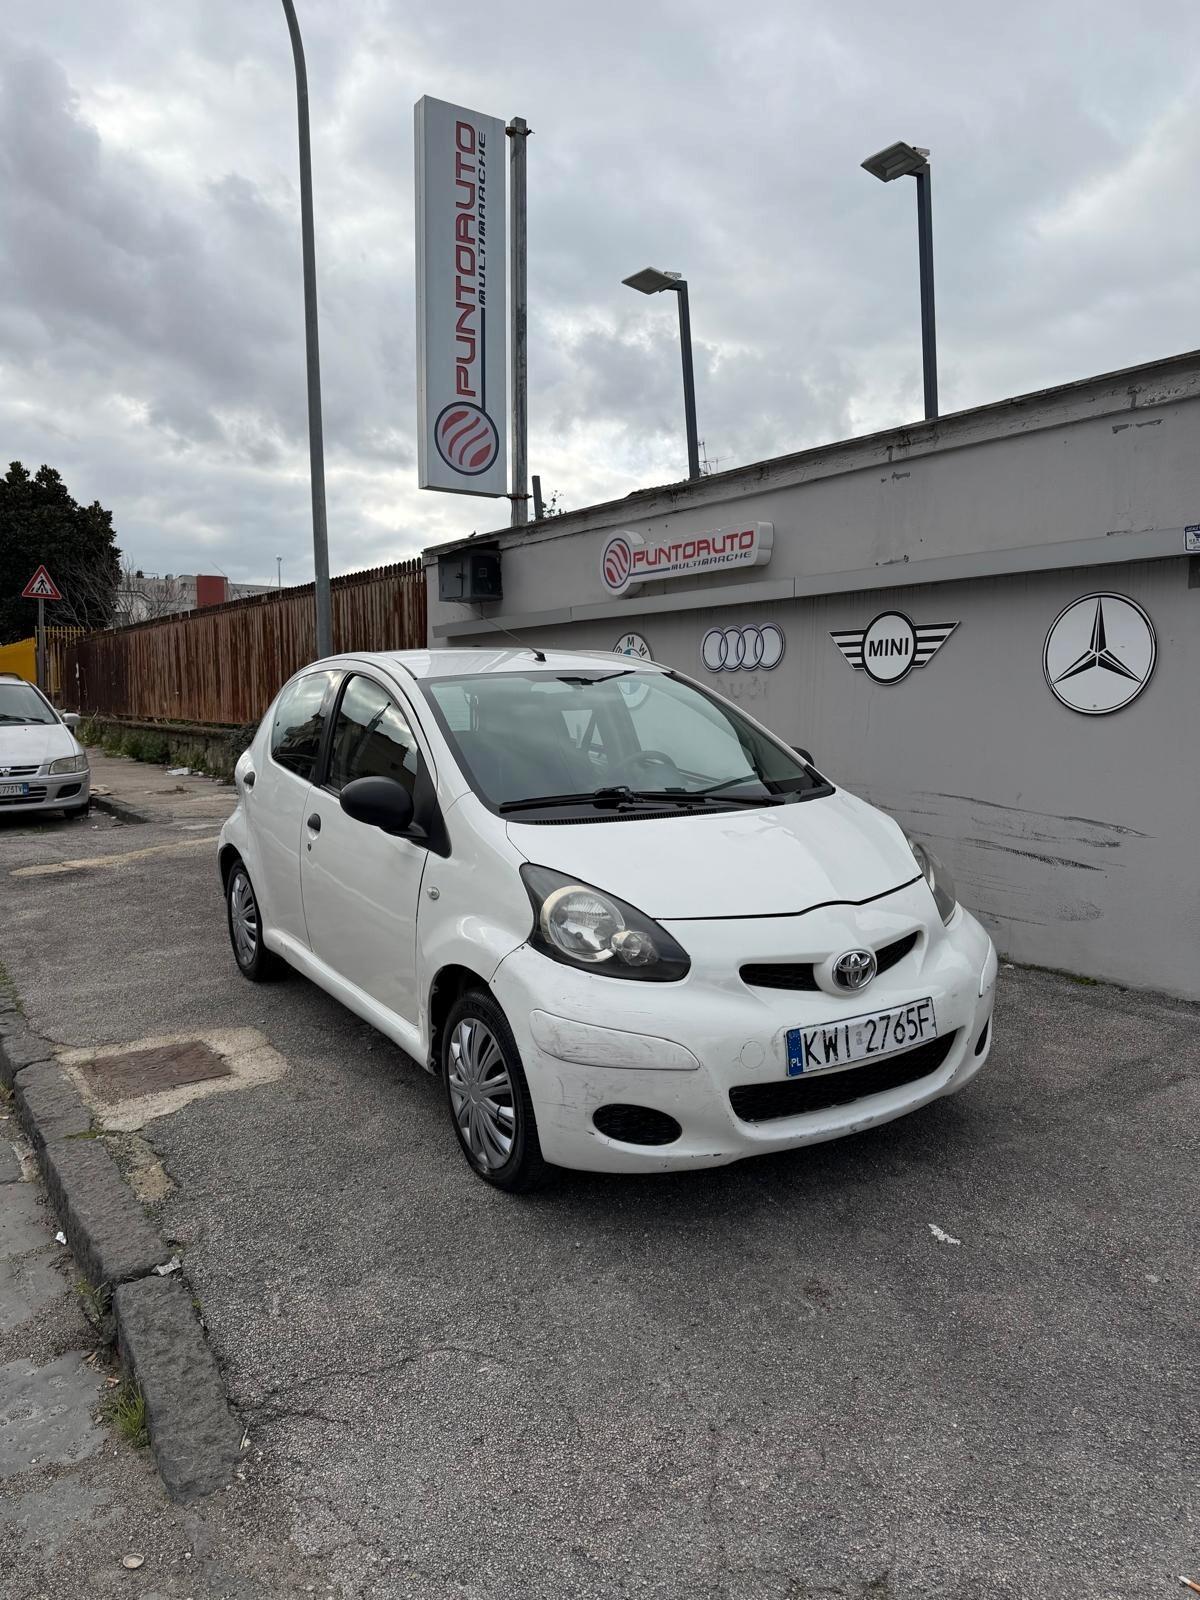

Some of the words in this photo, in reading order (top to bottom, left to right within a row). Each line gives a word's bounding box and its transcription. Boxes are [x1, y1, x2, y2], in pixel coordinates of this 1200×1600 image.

[478, 130, 486, 306] MULTIMARCHE
[455, 120, 477, 397] PUNTOAUTO
[633, 530, 755, 569] PUNTOAUTO
[671, 551, 753, 571] MULTIMARCHE
[615, 636, 647, 656] BMW
[868, 637, 910, 658] MINI
[803, 1025, 851, 1067] KWI
[864, 1003, 930, 1053] 2765F
[790, 1058, 801, 1067] PL
